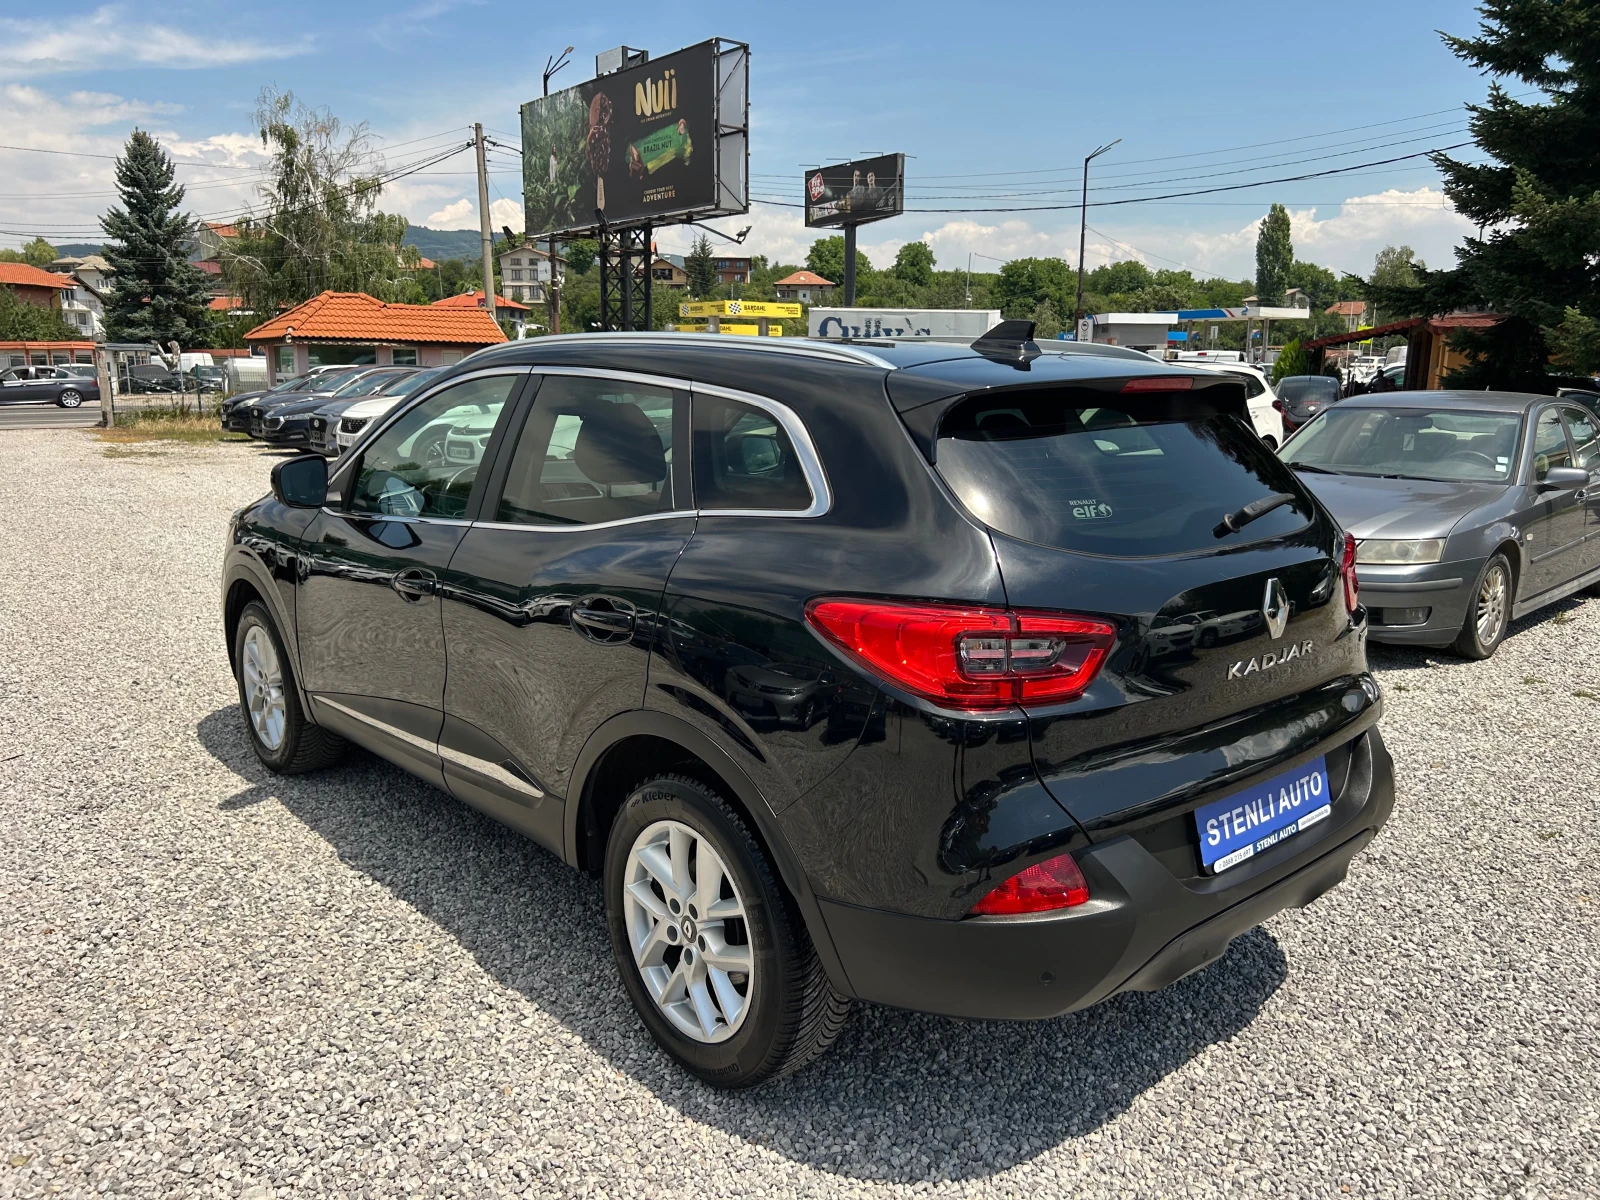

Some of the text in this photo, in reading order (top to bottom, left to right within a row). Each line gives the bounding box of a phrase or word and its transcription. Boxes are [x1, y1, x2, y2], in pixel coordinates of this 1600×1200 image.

[635, 69, 677, 117] Nuii
[643, 140, 672, 154] BRAZIL NUT
[642, 190, 676, 203] ADVENTURE
[744, 304, 767, 313] BARDAHL
[1073, 505, 1098, 518] elf
[1227, 639, 1314, 681] KADJAR
[641, 790, 676, 804] Kleber
[1206, 771, 1322, 846] STENLI AUTO
[1256, 834, 1278, 851] STENLI
[1279, 824, 1297, 840] AUTO
